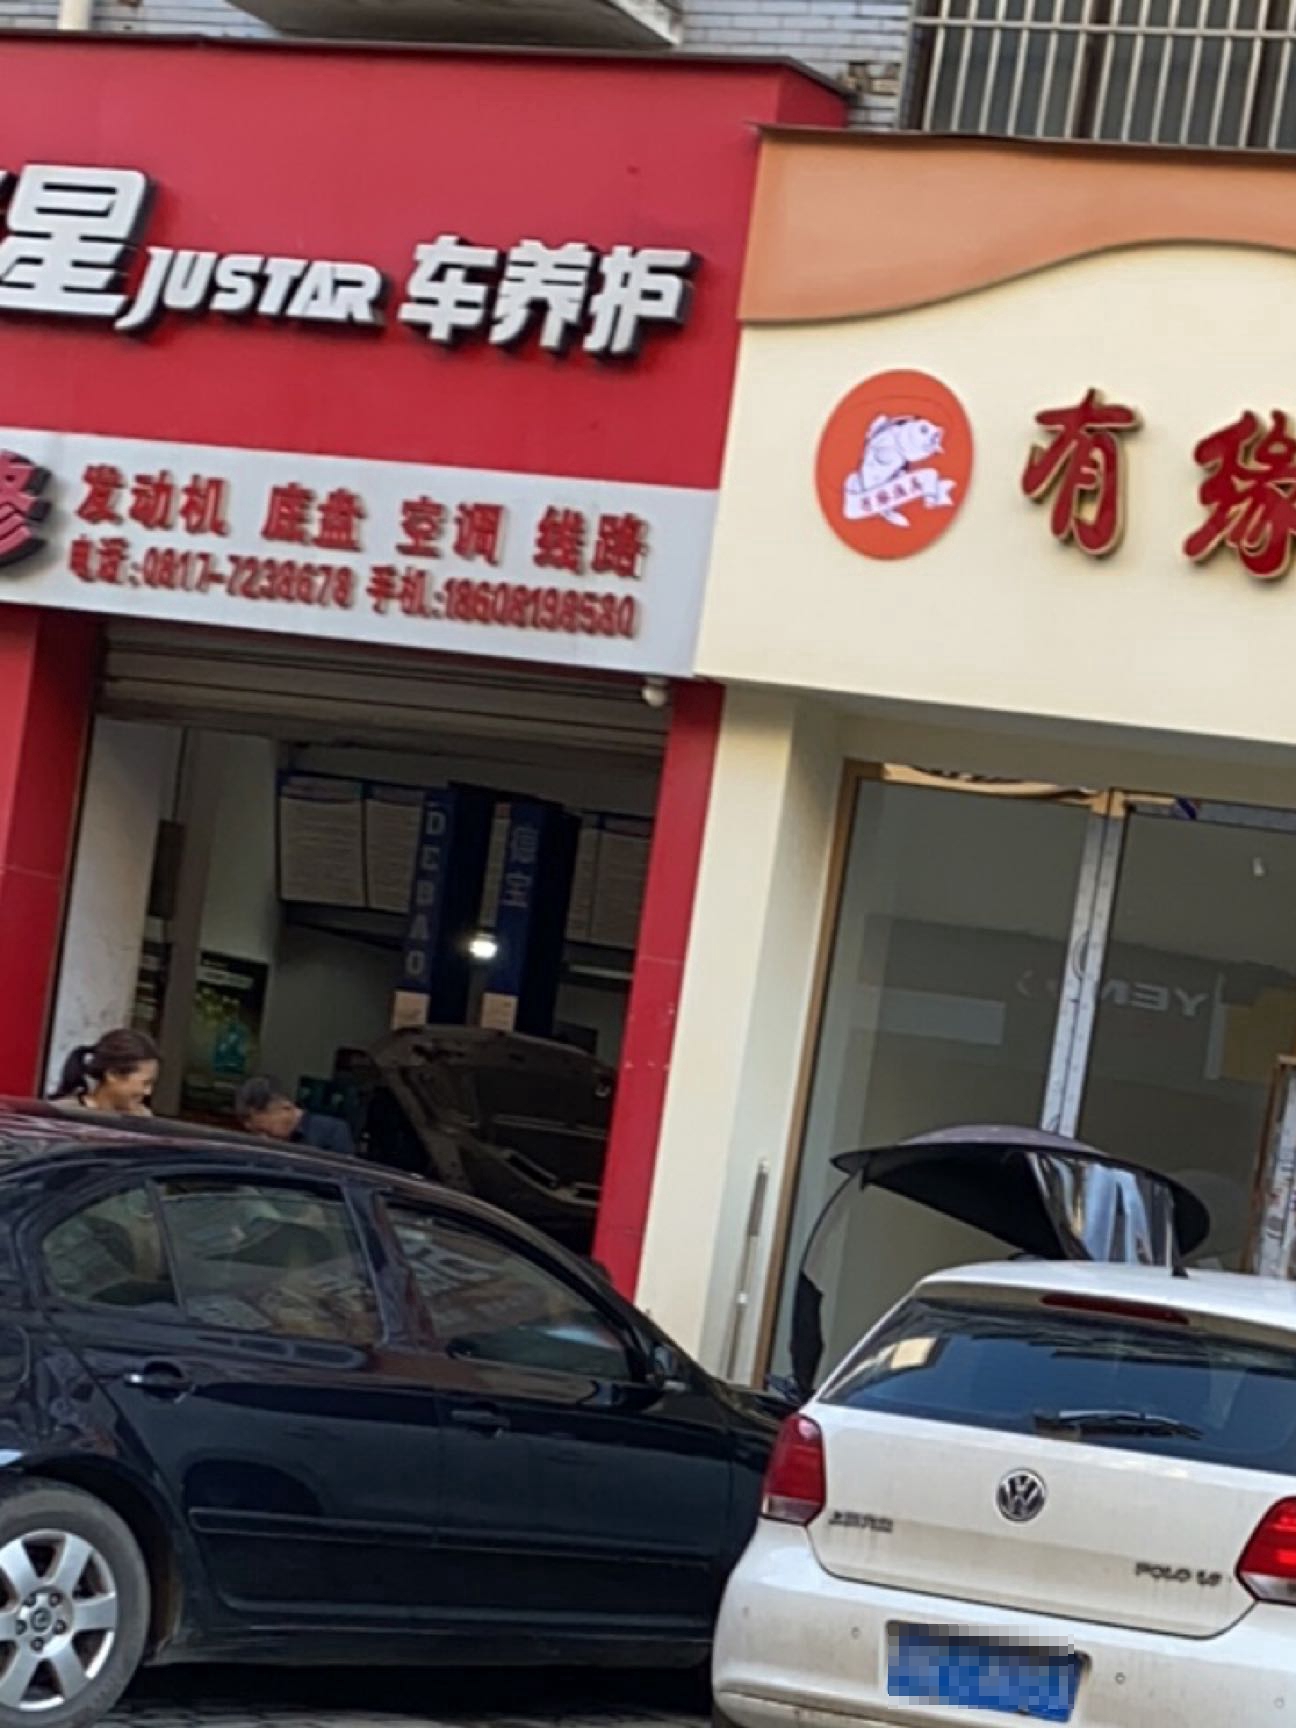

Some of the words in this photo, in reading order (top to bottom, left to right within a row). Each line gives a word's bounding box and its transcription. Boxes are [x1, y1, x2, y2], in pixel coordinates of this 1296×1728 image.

[0, 164, 146, 316] 星
[114, 246, 384, 329] JUSTAR
[398, 236, 692, 353] 车养护
[76, 463, 229, 537] 发动机
[261, 482, 364, 553] 底盘
[395, 496, 505, 566] 空调
[533, 505, 651, 580] 线路
